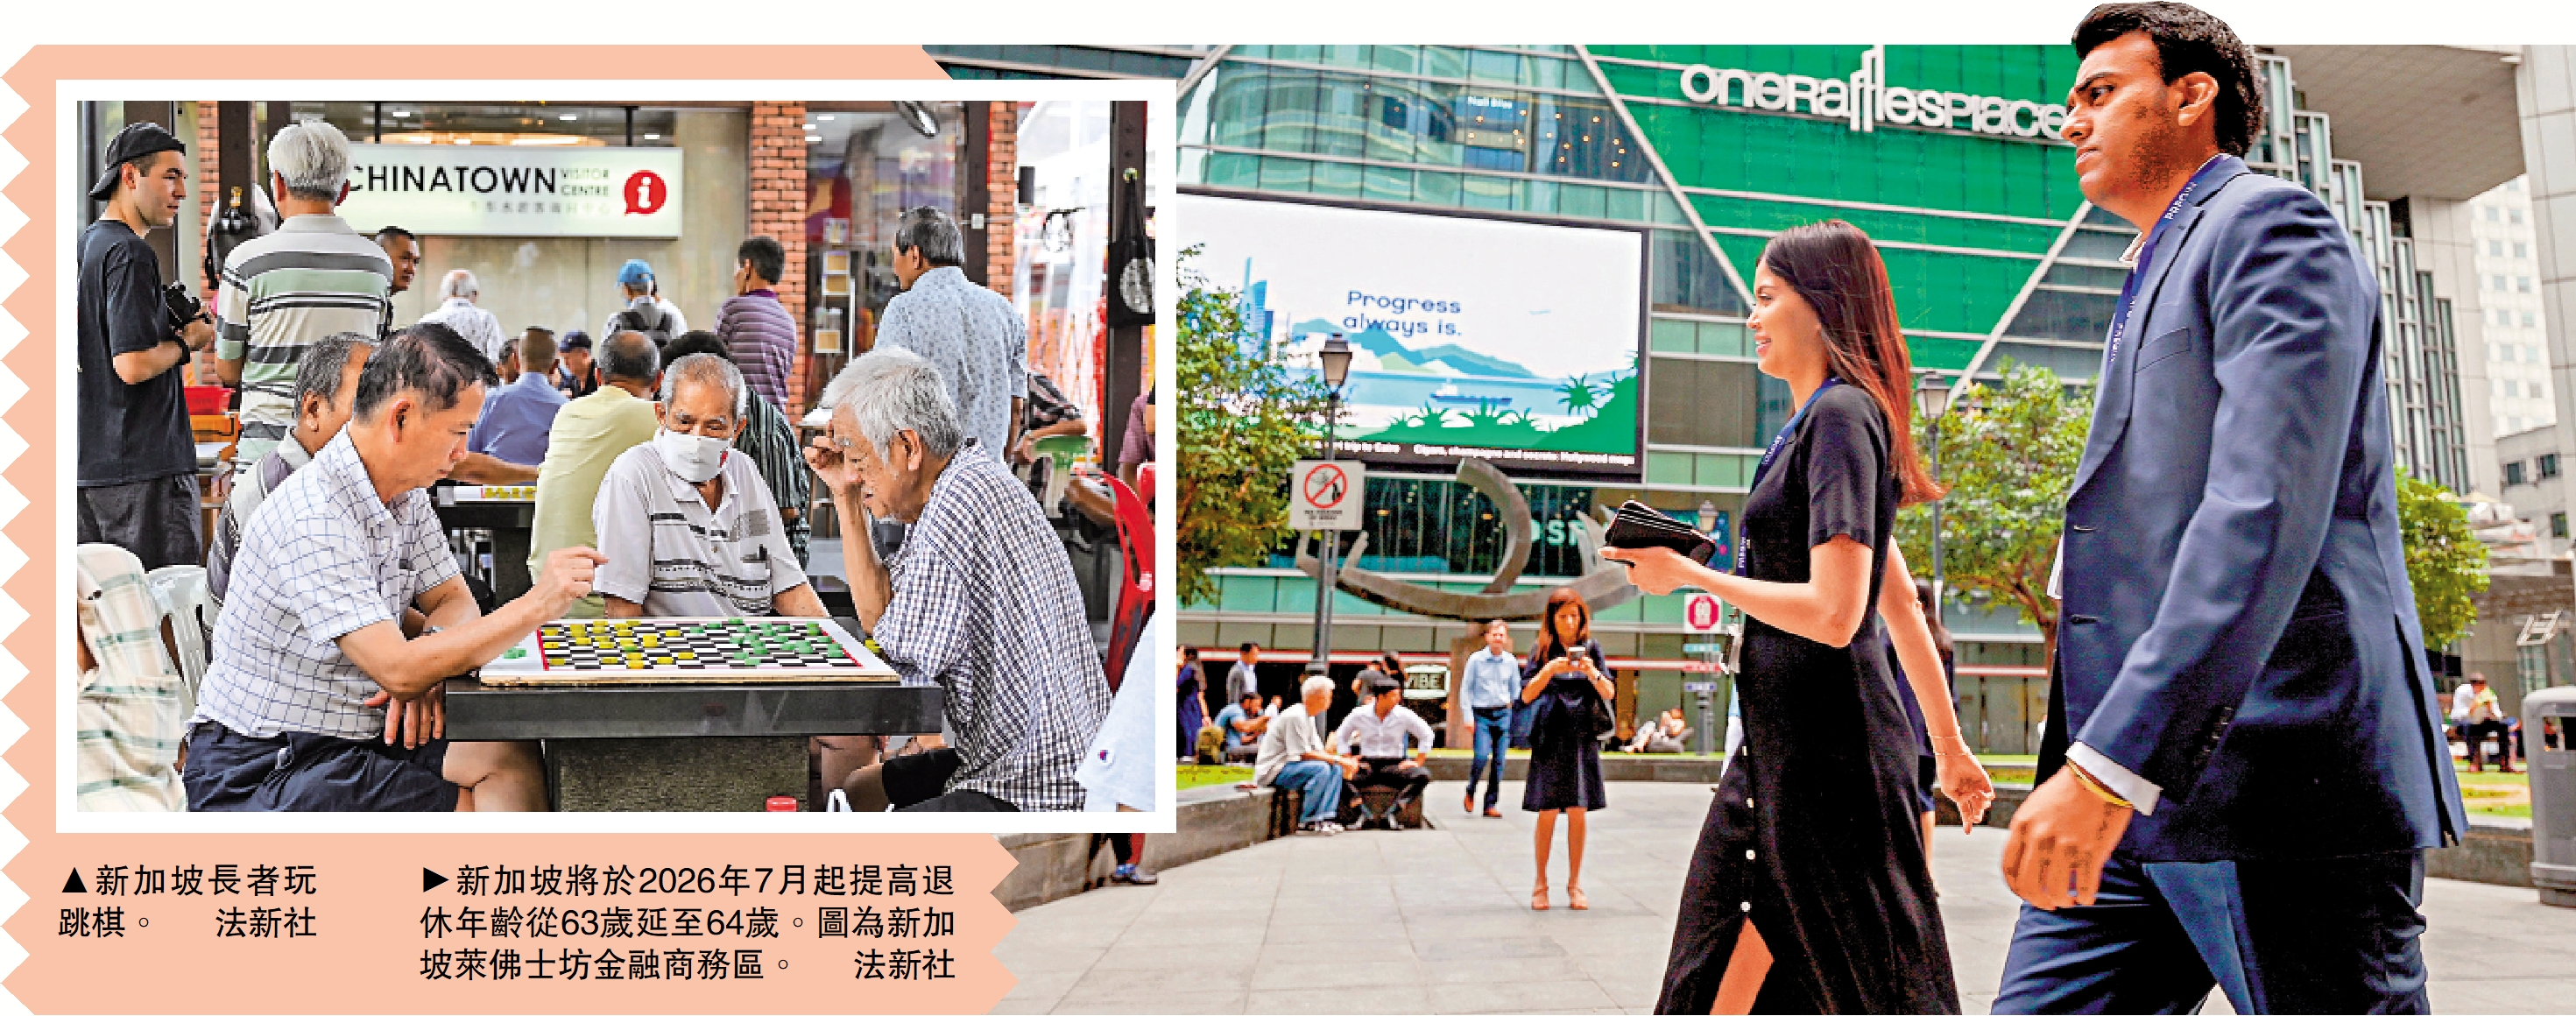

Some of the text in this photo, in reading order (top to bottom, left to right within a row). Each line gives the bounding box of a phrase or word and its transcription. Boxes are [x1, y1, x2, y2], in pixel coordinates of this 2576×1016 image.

[560, 167, 610, 180] VISITOR
[560, 184, 610, 196] CENTRE
[1347, 290, 1461, 314] Progress
[1343, 313, 1463, 338] always is.
[1502, 448, 1522, 459] and
